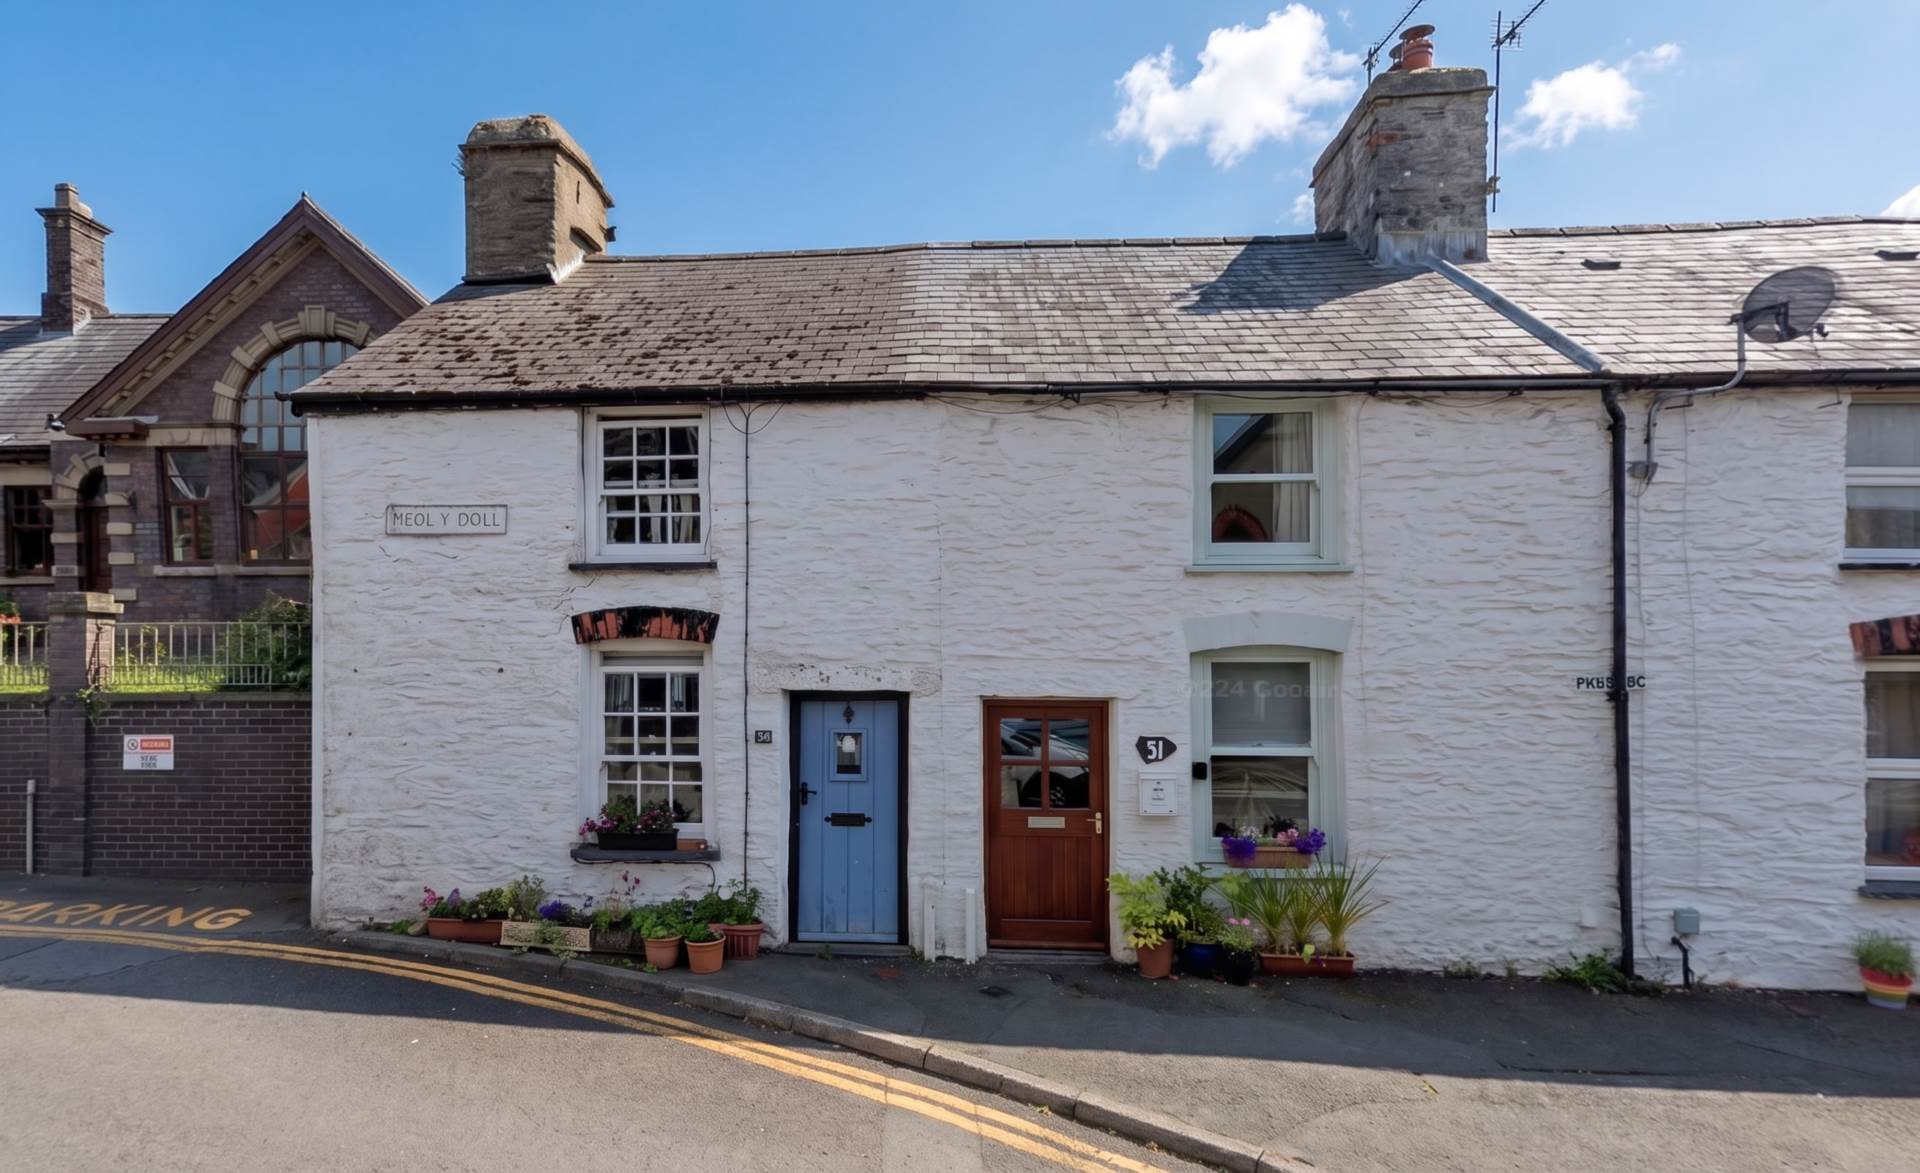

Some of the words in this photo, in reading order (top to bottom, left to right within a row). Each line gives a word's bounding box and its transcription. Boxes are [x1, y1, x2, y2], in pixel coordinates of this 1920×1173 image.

[393, 512, 434, 527] MEOL
[440, 512, 450, 526] Y
[458, 512, 501, 527] DOLL
[1146, 740, 1163, 760] 51
[0, 900, 253, 930] ARKING
